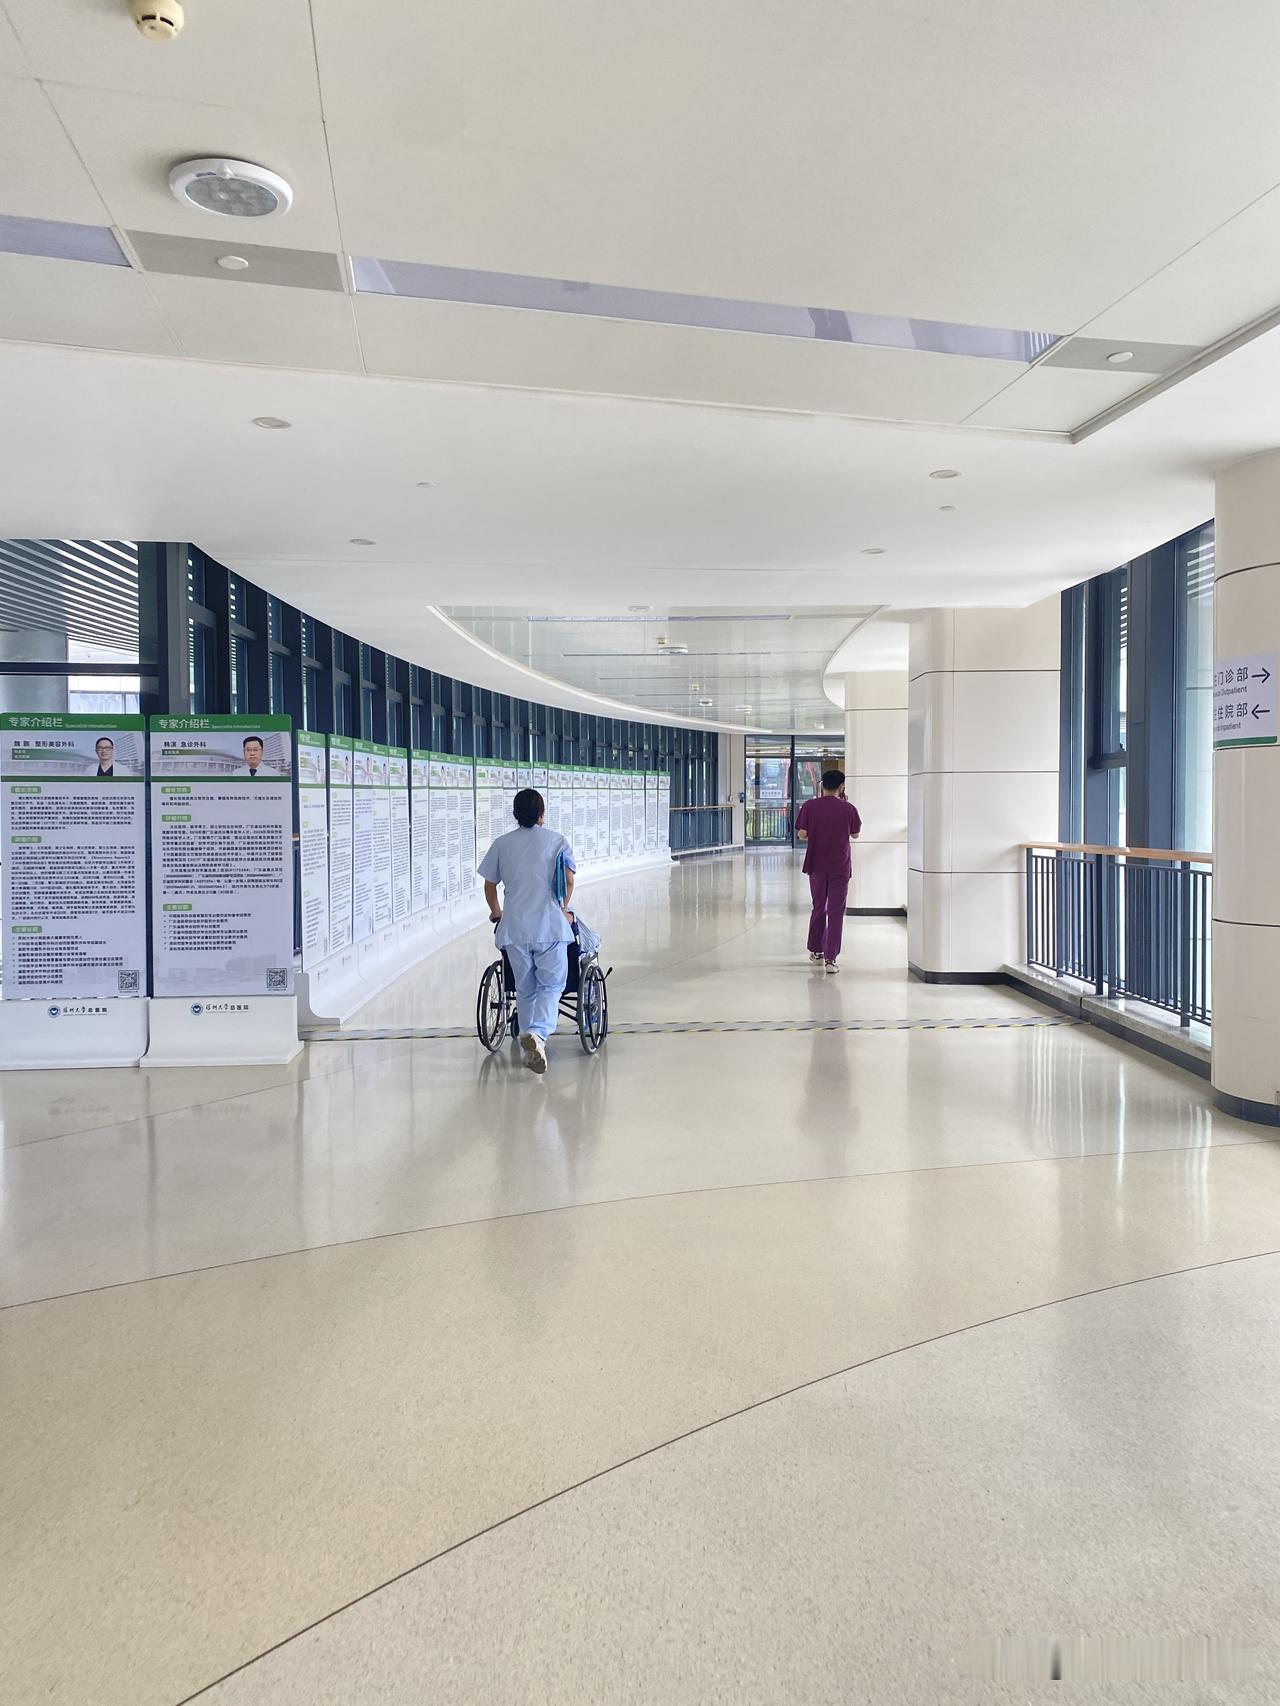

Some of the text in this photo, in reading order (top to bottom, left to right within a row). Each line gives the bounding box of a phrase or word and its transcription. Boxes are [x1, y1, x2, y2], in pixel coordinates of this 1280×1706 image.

[8, 717, 63, 728] 专家介绍栏
[158, 718, 211, 729] 专家介绍栏
[35, 740, 75, 748] 整形美容外科
[180, 740, 207, 748] 急诊外科
